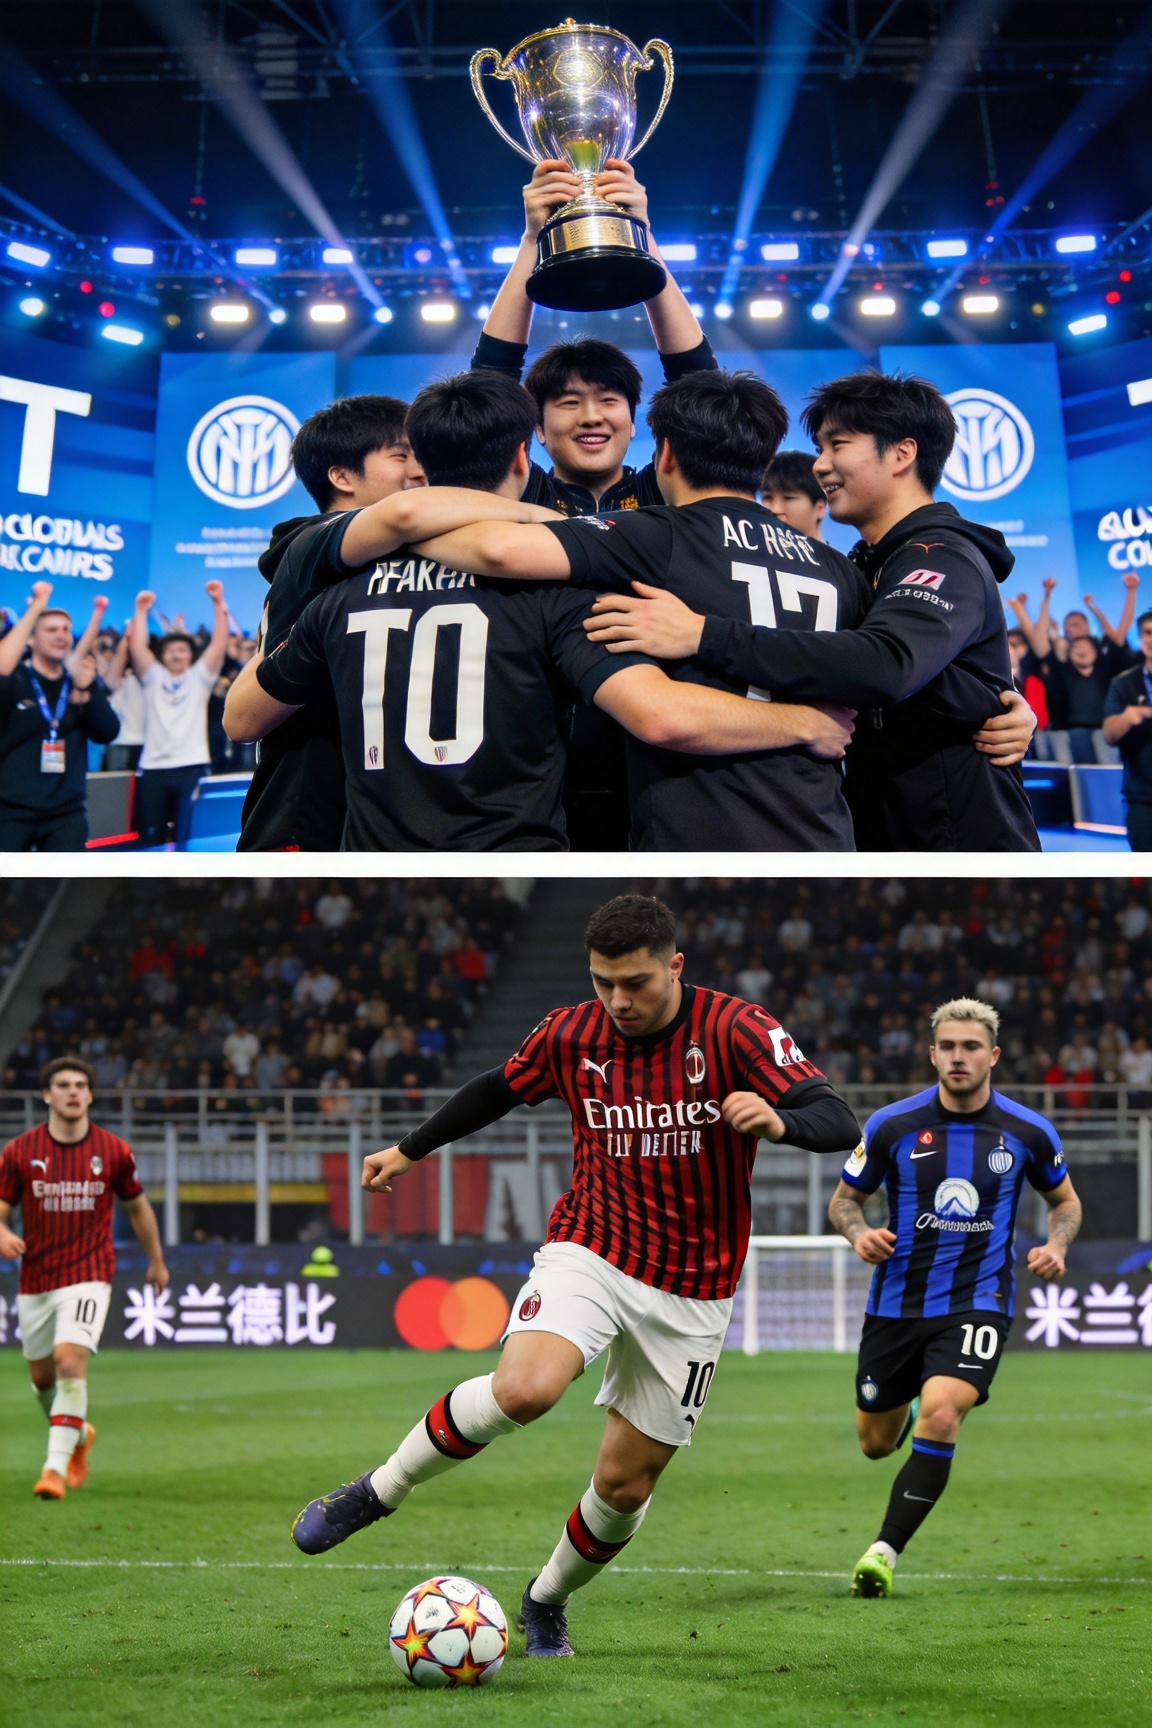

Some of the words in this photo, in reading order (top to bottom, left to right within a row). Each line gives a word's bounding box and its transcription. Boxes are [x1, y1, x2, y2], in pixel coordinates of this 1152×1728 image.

[722, 515, 759, 550] AC
[583, 1096, 721, 1129] Emirates
[75, 1297, 97, 1325] 10
[124, 1282, 337, 1346] 米兰德比
[961, 1323, 998, 1360] 10
[680, 1361, 715, 1408] 10
